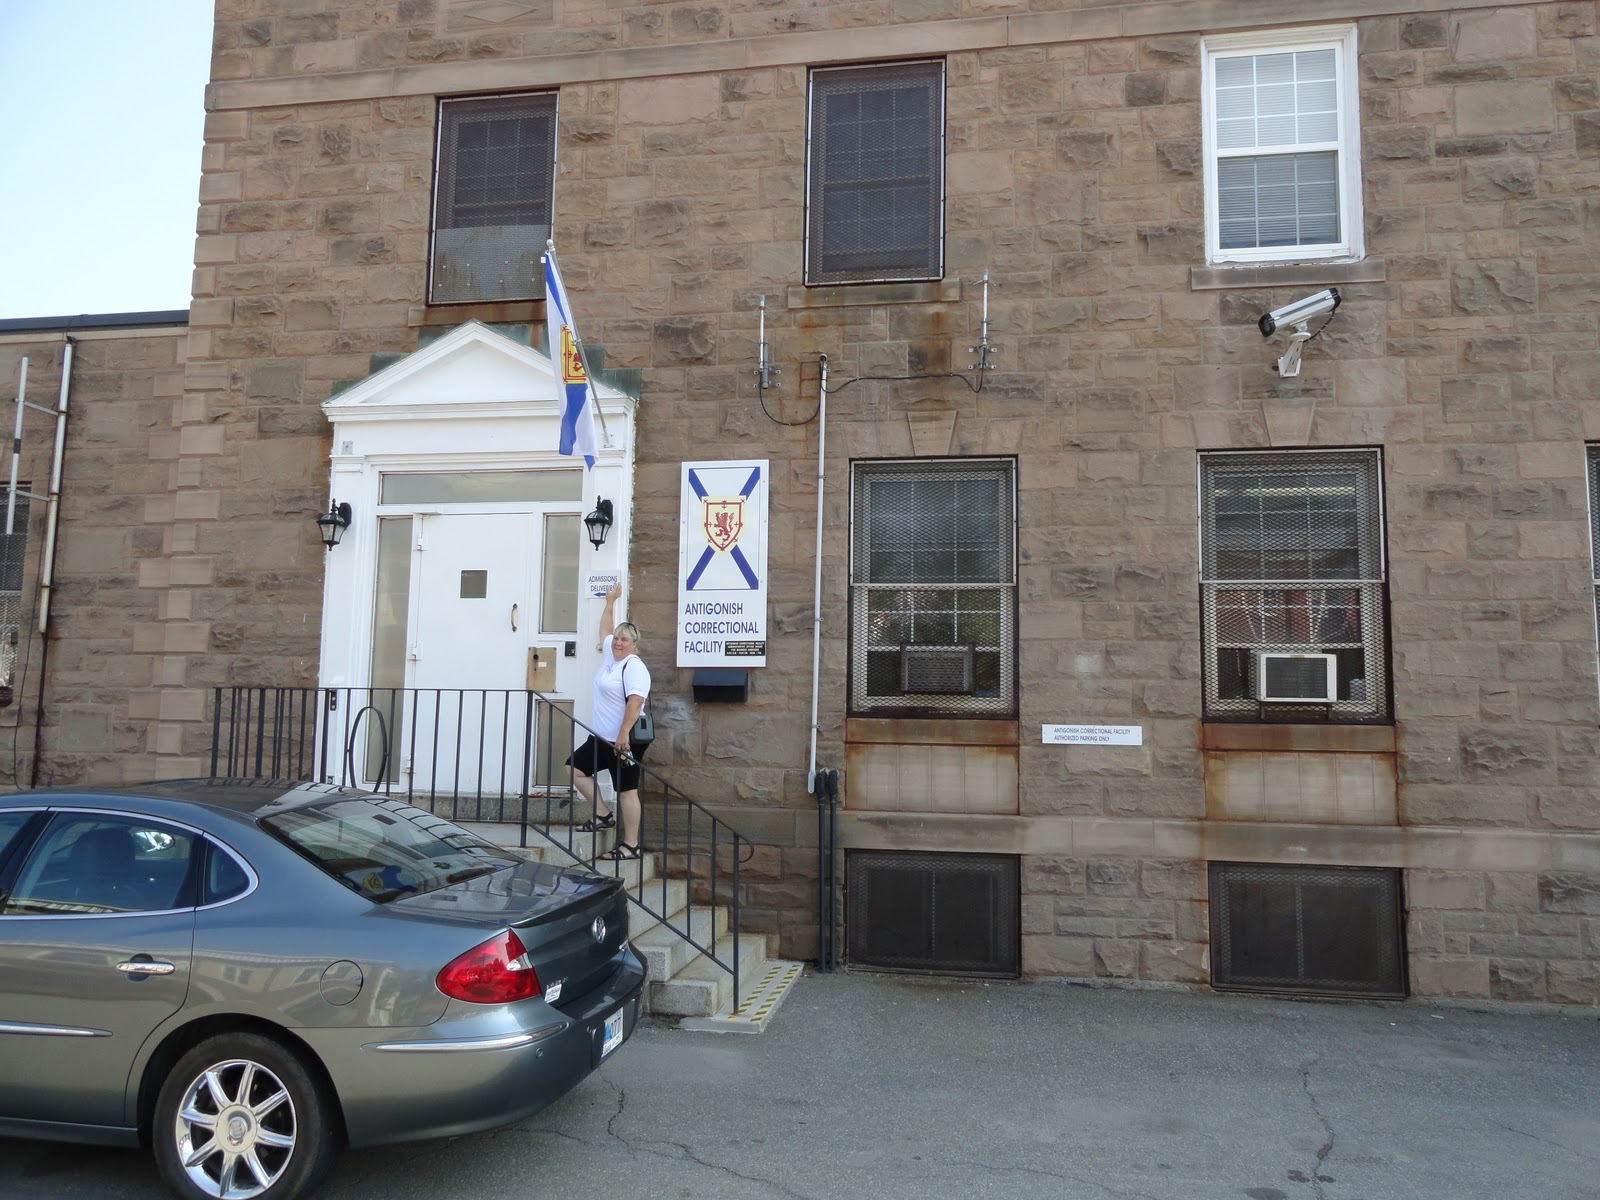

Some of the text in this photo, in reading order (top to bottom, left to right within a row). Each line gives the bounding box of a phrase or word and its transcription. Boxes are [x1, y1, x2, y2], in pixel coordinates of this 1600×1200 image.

[588, 575, 618, 583] ADMISSIONS
[590, 584, 616, 592] DELIVERES
[684, 602, 743, 615] ANTIGONISH
[684, 621, 759, 634] CORRECTIONAL
[684, 640, 723, 653] FACILITY
